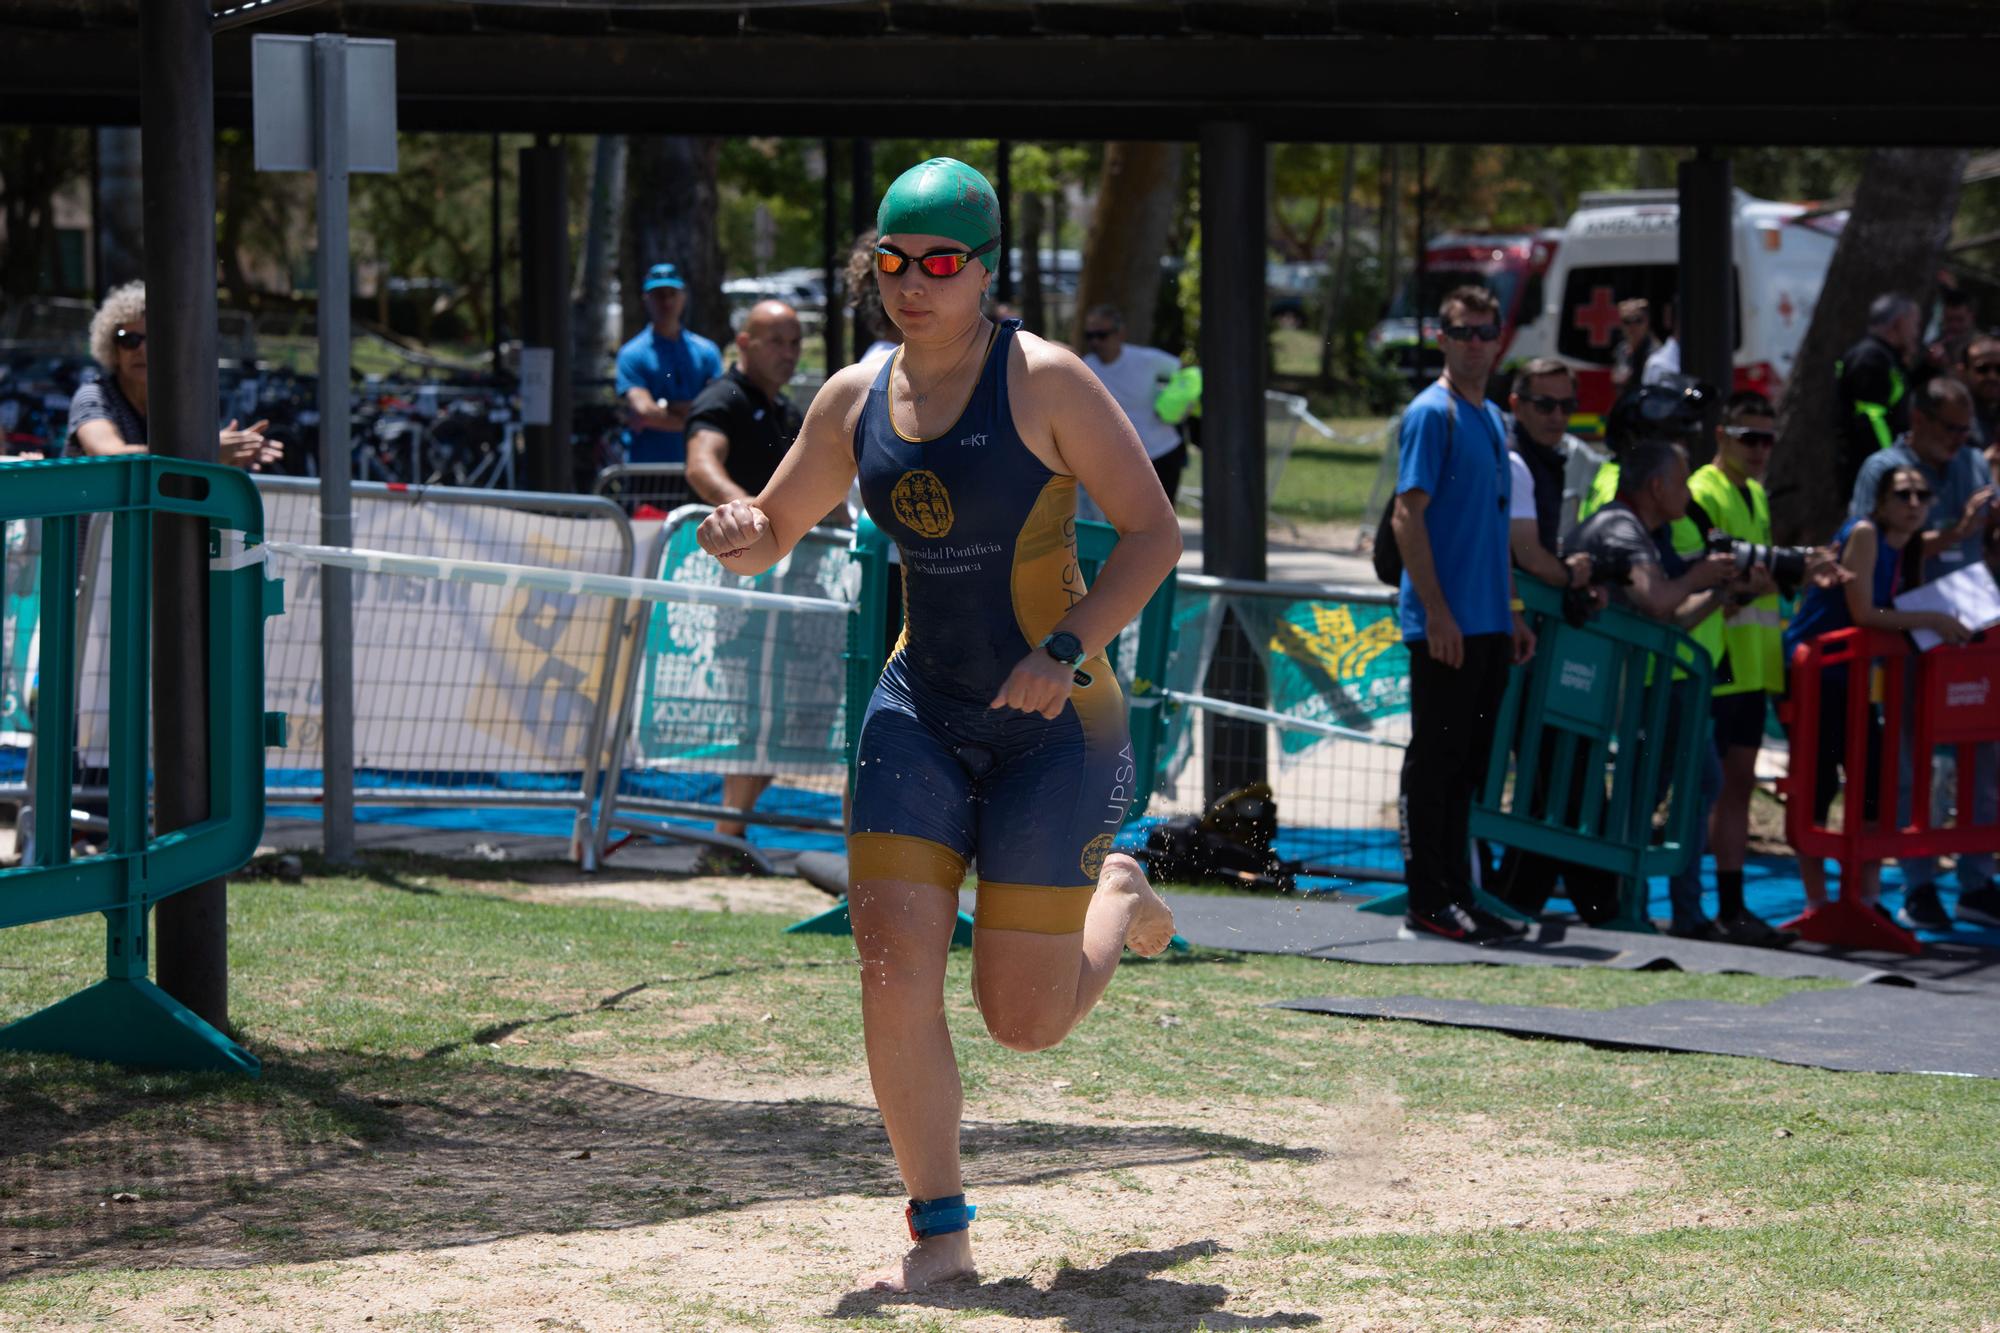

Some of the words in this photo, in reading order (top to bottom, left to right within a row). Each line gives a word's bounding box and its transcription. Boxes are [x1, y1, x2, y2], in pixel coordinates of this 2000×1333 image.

[1584, 217, 1678, 235] AMBULA
[945, 542, 1002, 559] Pontificia
[920, 562, 982, 575] Salamanca
[1103, 740, 1134, 824] UPSA
